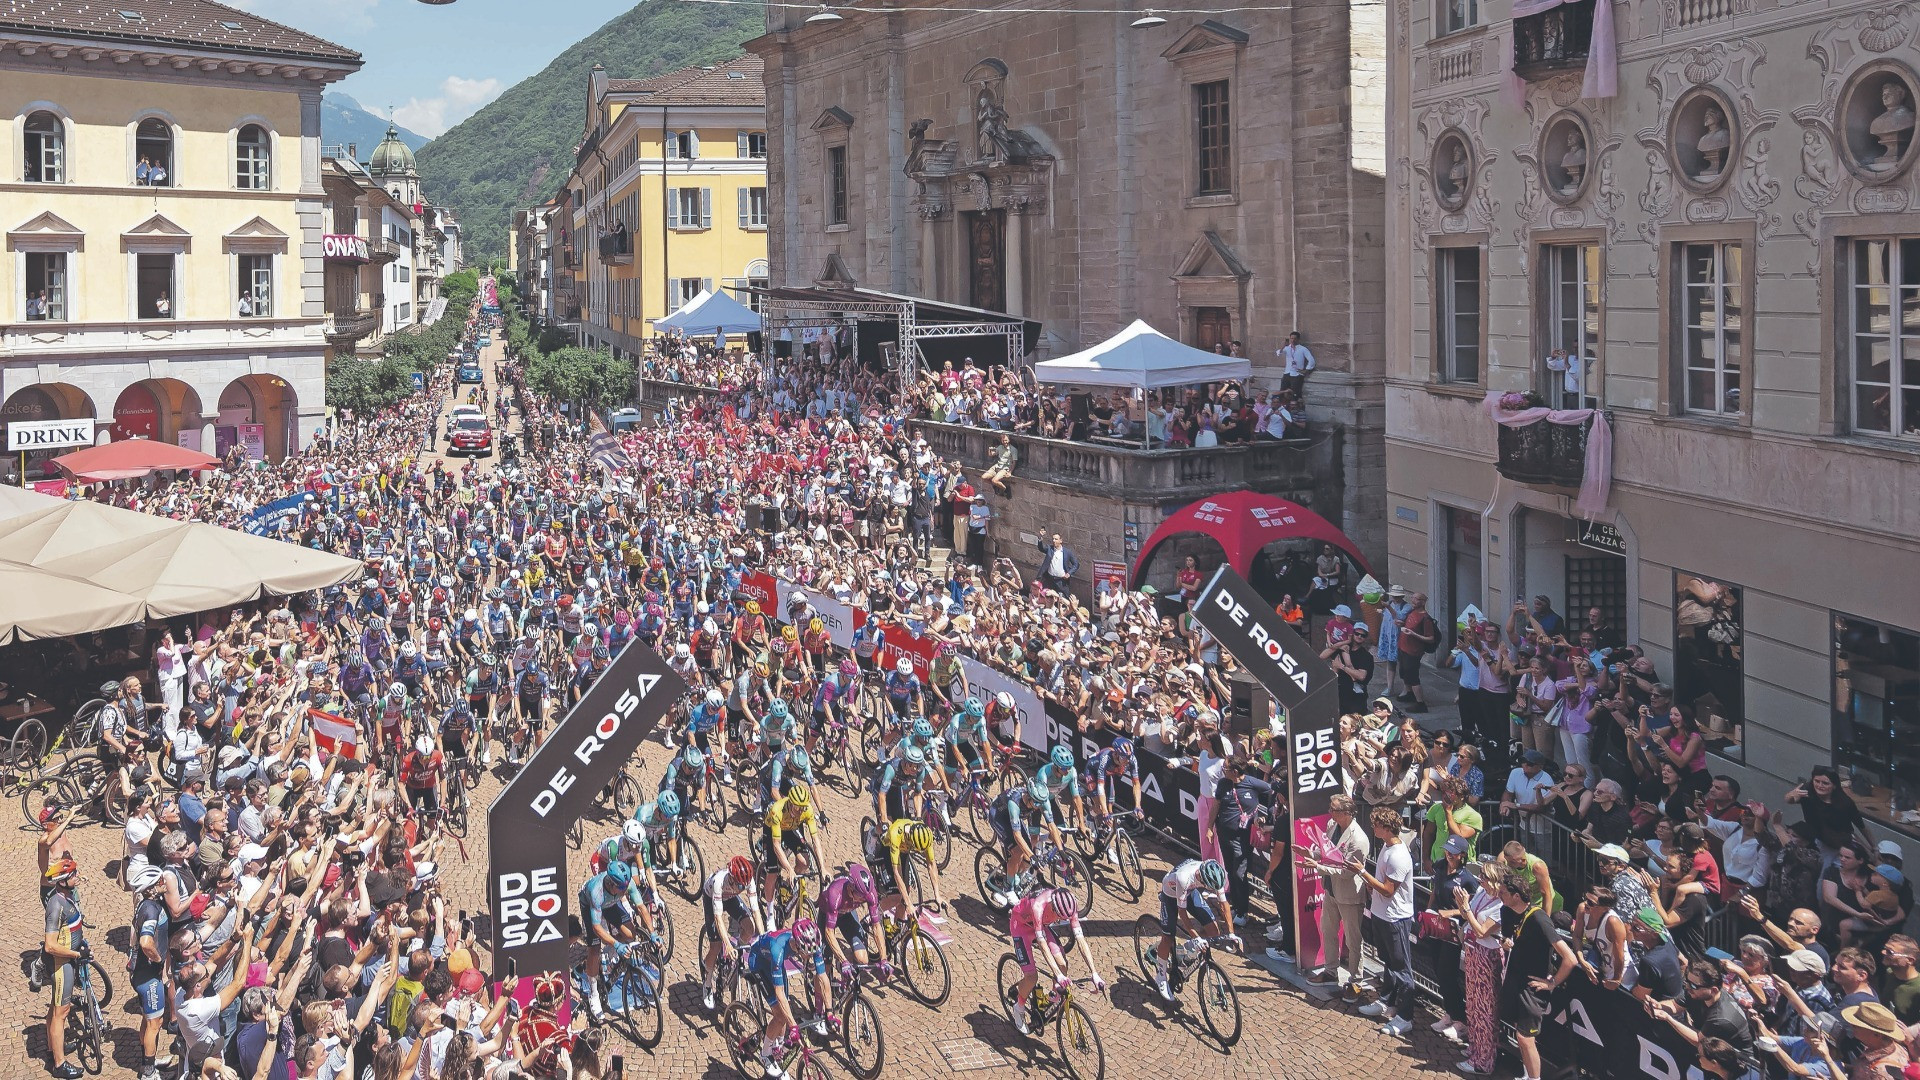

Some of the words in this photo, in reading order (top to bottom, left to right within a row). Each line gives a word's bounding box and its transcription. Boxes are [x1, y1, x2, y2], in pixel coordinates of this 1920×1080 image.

[1695, 205, 1719, 215] DANTE
[0, 402, 42, 415] ickets
[16, 427, 88, 445] DRINK
[1586, 532, 1618, 548] PIAZZA
[1619, 540, 1626, 549] G
[1602, 525, 1620, 537] CEN
[739, 582, 769, 601] TROËN
[815, 610, 844, 632] ROËN
[1215, 588, 1250, 627] DE
[1248, 622, 1308, 693] ROSA
[884, 641, 929, 672] ITROËN
[1046, 714, 1073, 752] DE
[1295, 727, 1334, 753] DE
[530, 766, 577, 818] DE
[574, 673, 663, 766] ROSA
[1296, 749, 1337, 774] RO
[1298, 769, 1339, 793] SA
[499, 866, 558, 899] DE
[500, 893, 562, 924] RO
[1307, 893, 1325, 905] AM
[502, 919, 564, 949] SA
